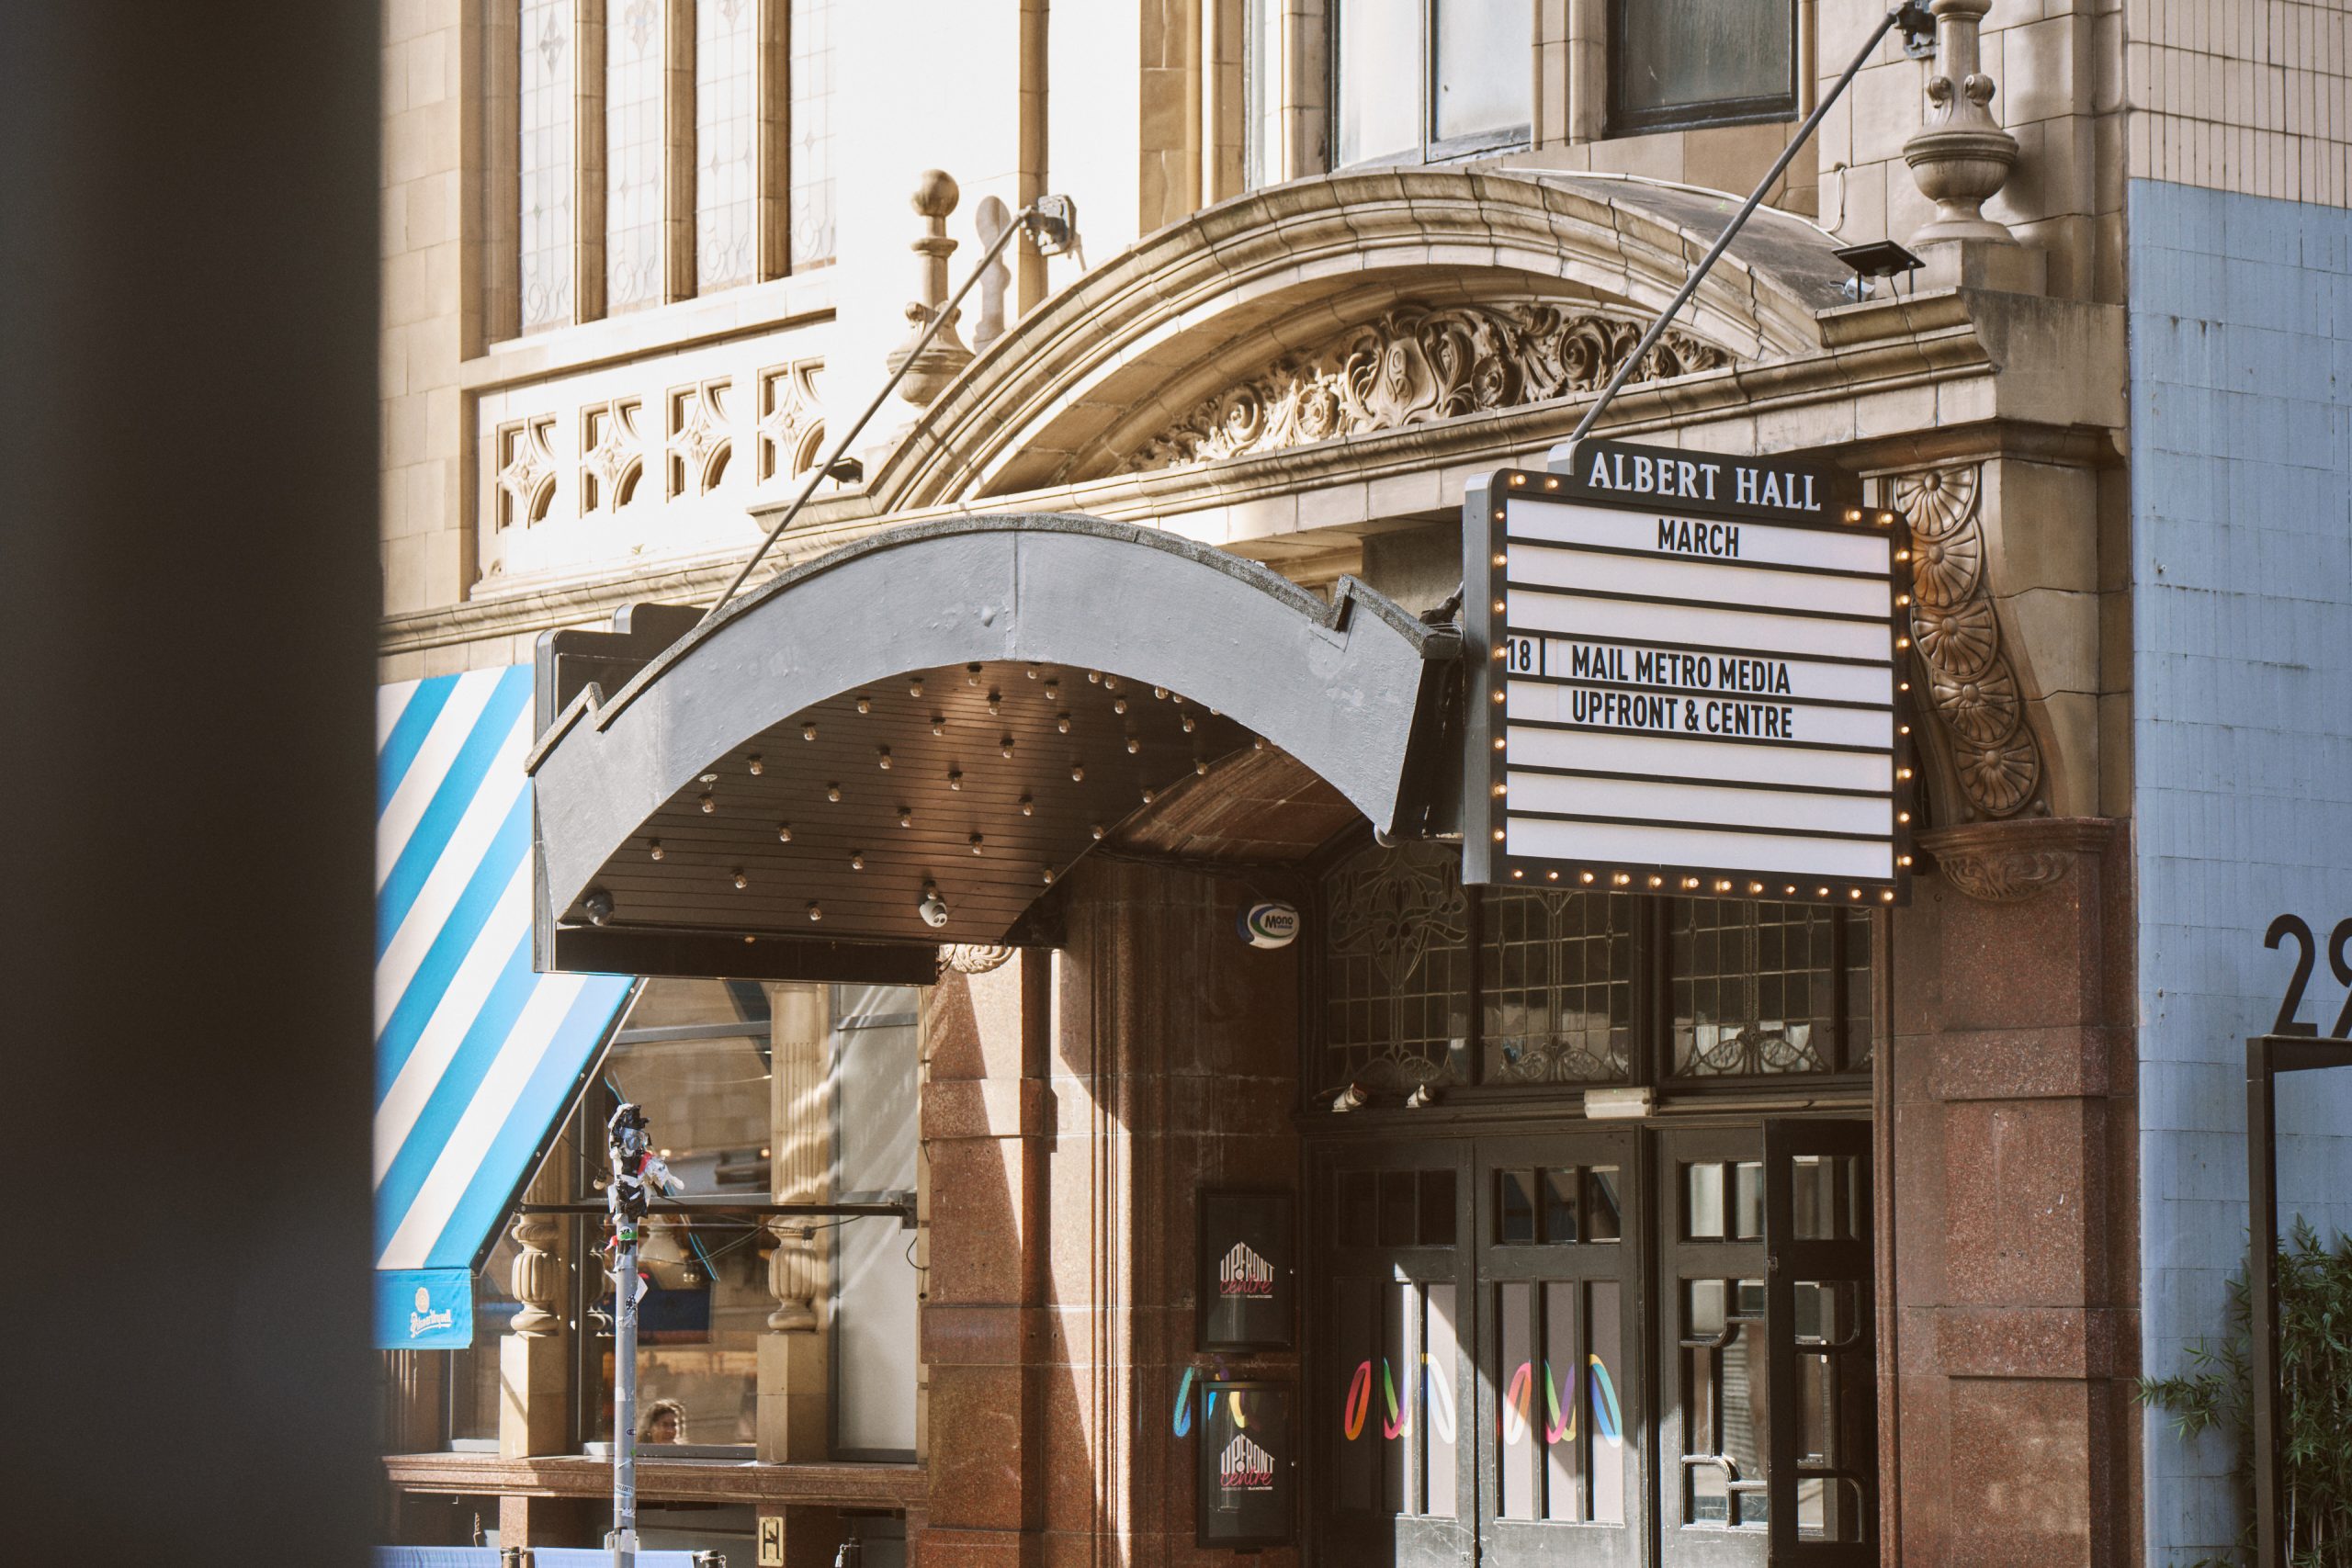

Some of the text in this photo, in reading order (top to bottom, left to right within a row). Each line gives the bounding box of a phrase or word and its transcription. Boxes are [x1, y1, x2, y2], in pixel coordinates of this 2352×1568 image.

[1589, 452, 1821, 511] ALBERT HALL
[1658, 518, 1740, 558] MARCH
[1508, 638, 1792, 694] 18 MAIL METRO MEDIA
[1572, 690, 1793, 739] UPFRONT & CENTRE
[1220, 1241, 1275, 1282] UPFRONT
[1220, 1433, 1275, 1474] UPFRONT
